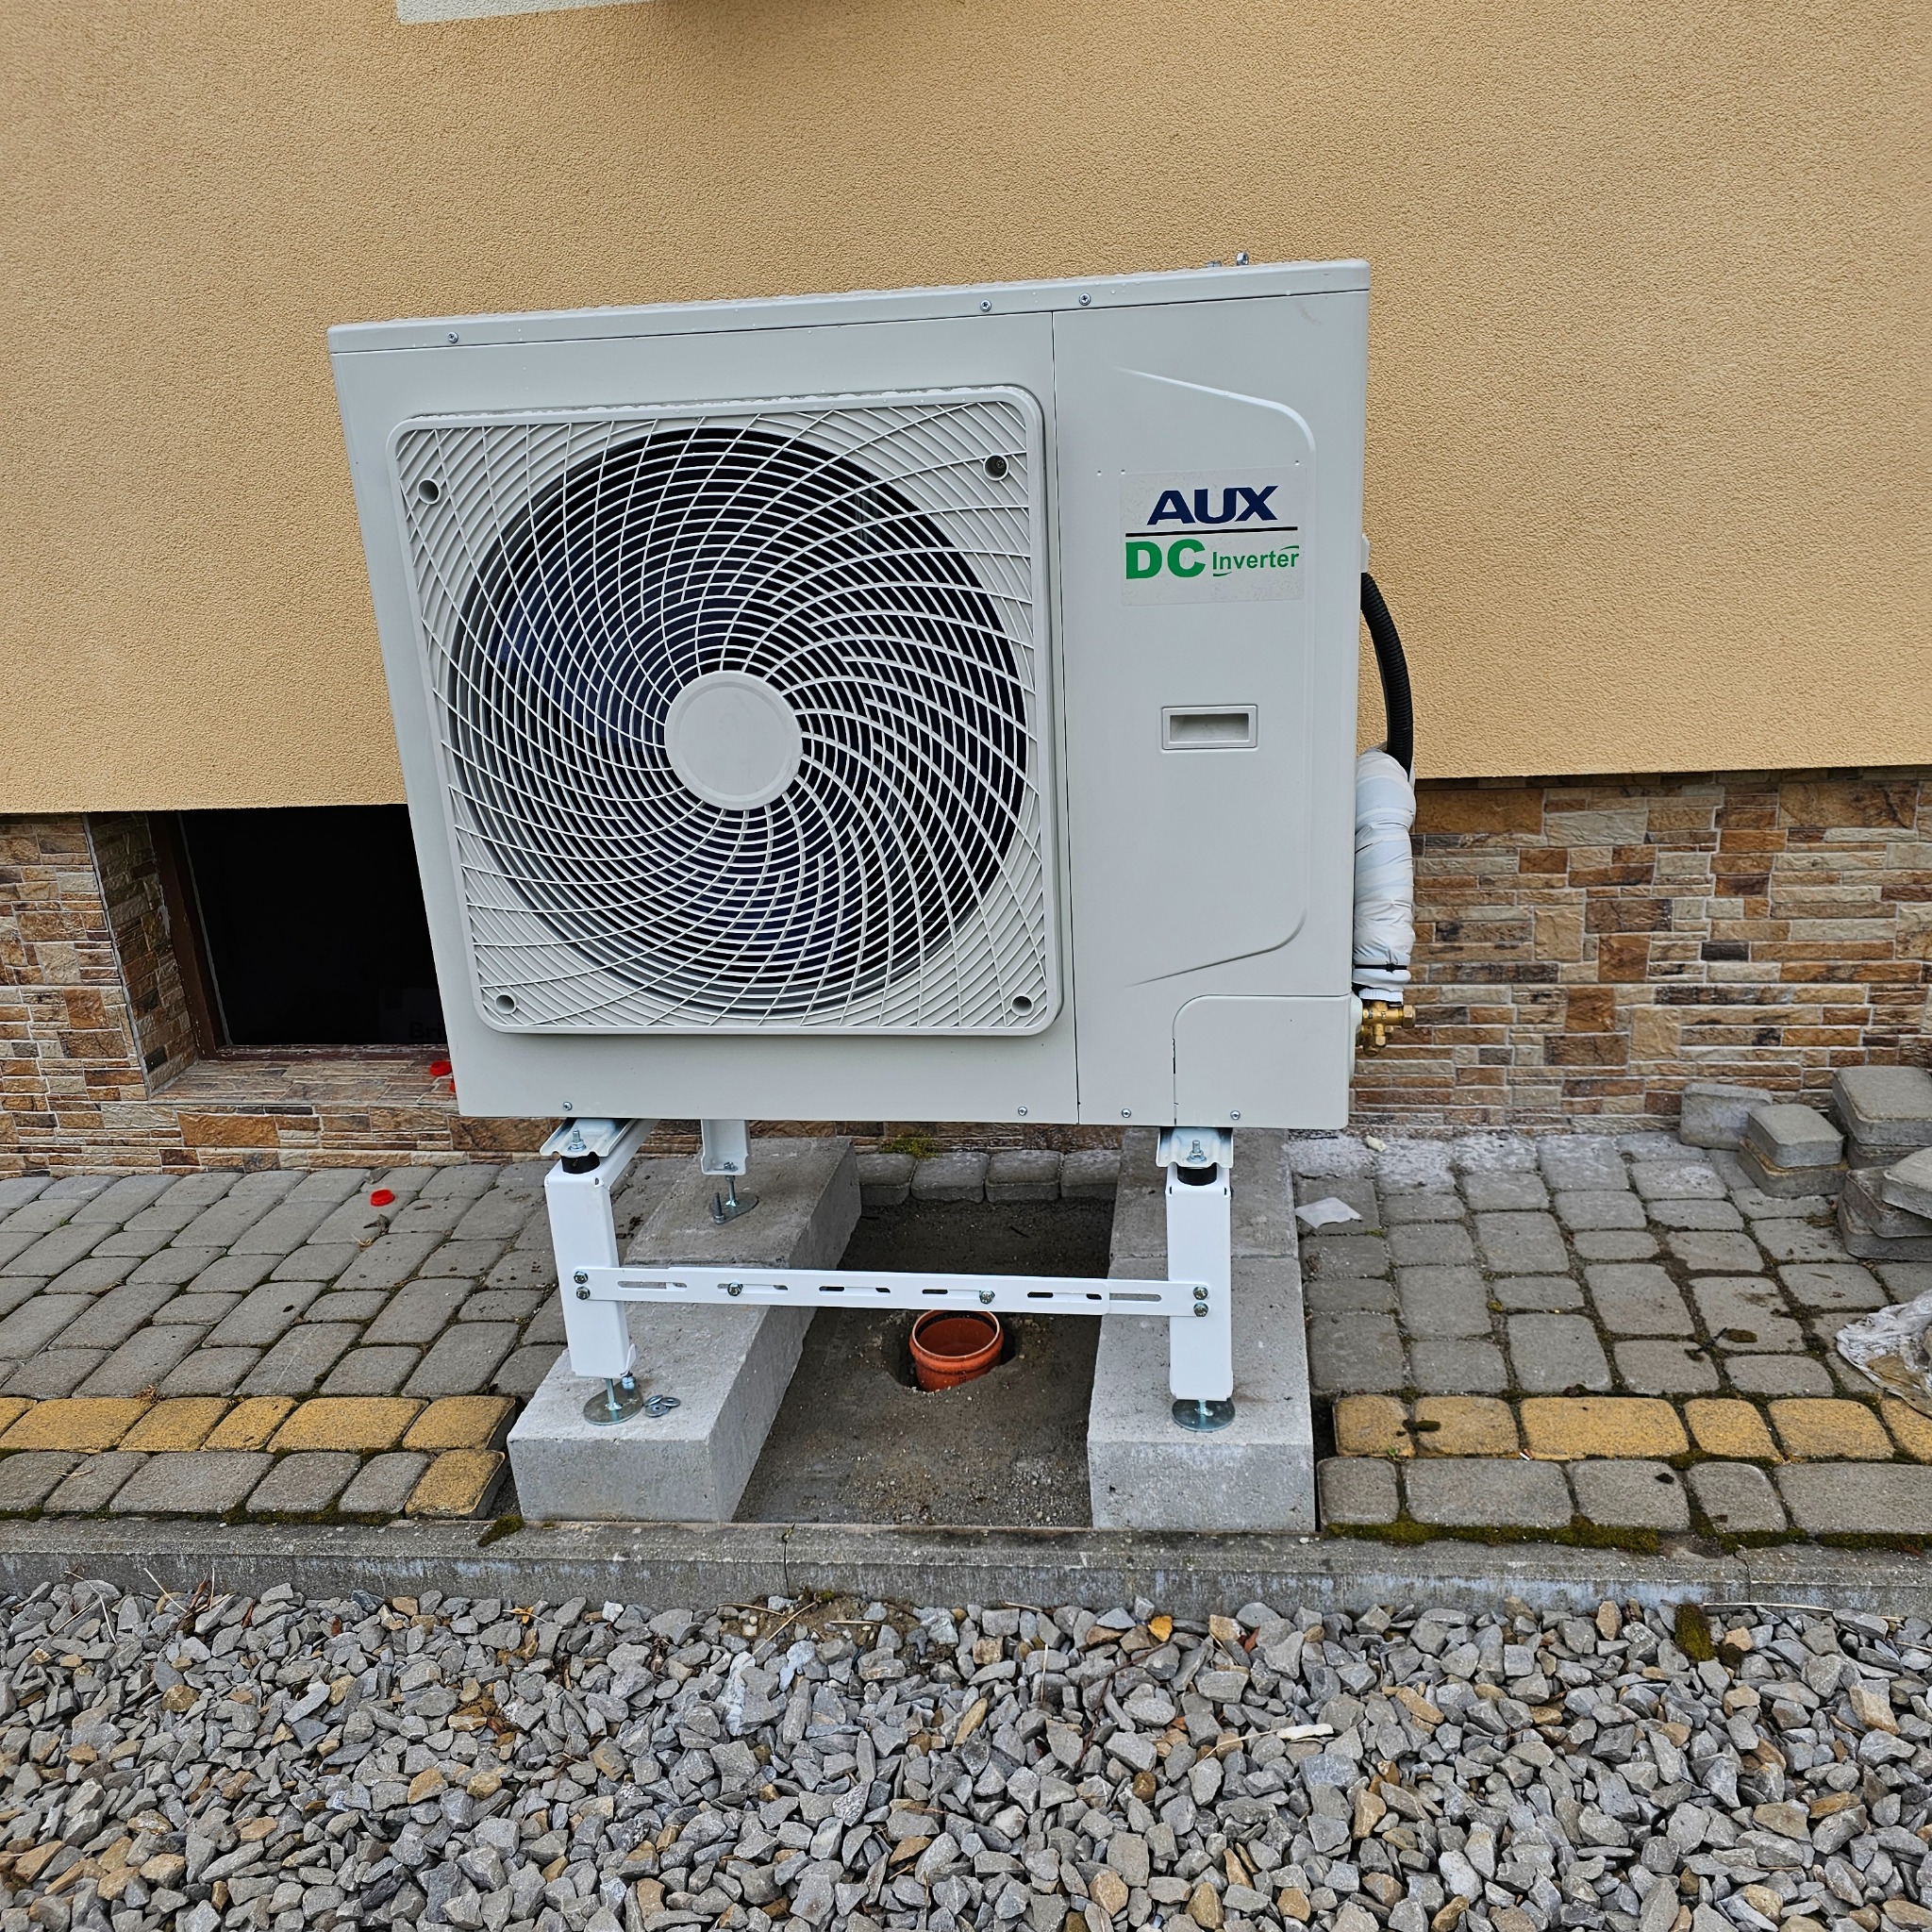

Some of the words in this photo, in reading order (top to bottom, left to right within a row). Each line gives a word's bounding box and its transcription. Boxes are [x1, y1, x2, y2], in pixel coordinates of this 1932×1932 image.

[1147, 485, 1279, 525] AUX
[1125, 538, 1206, 579] DC
[1212, 550, 1299, 570] Inverter
